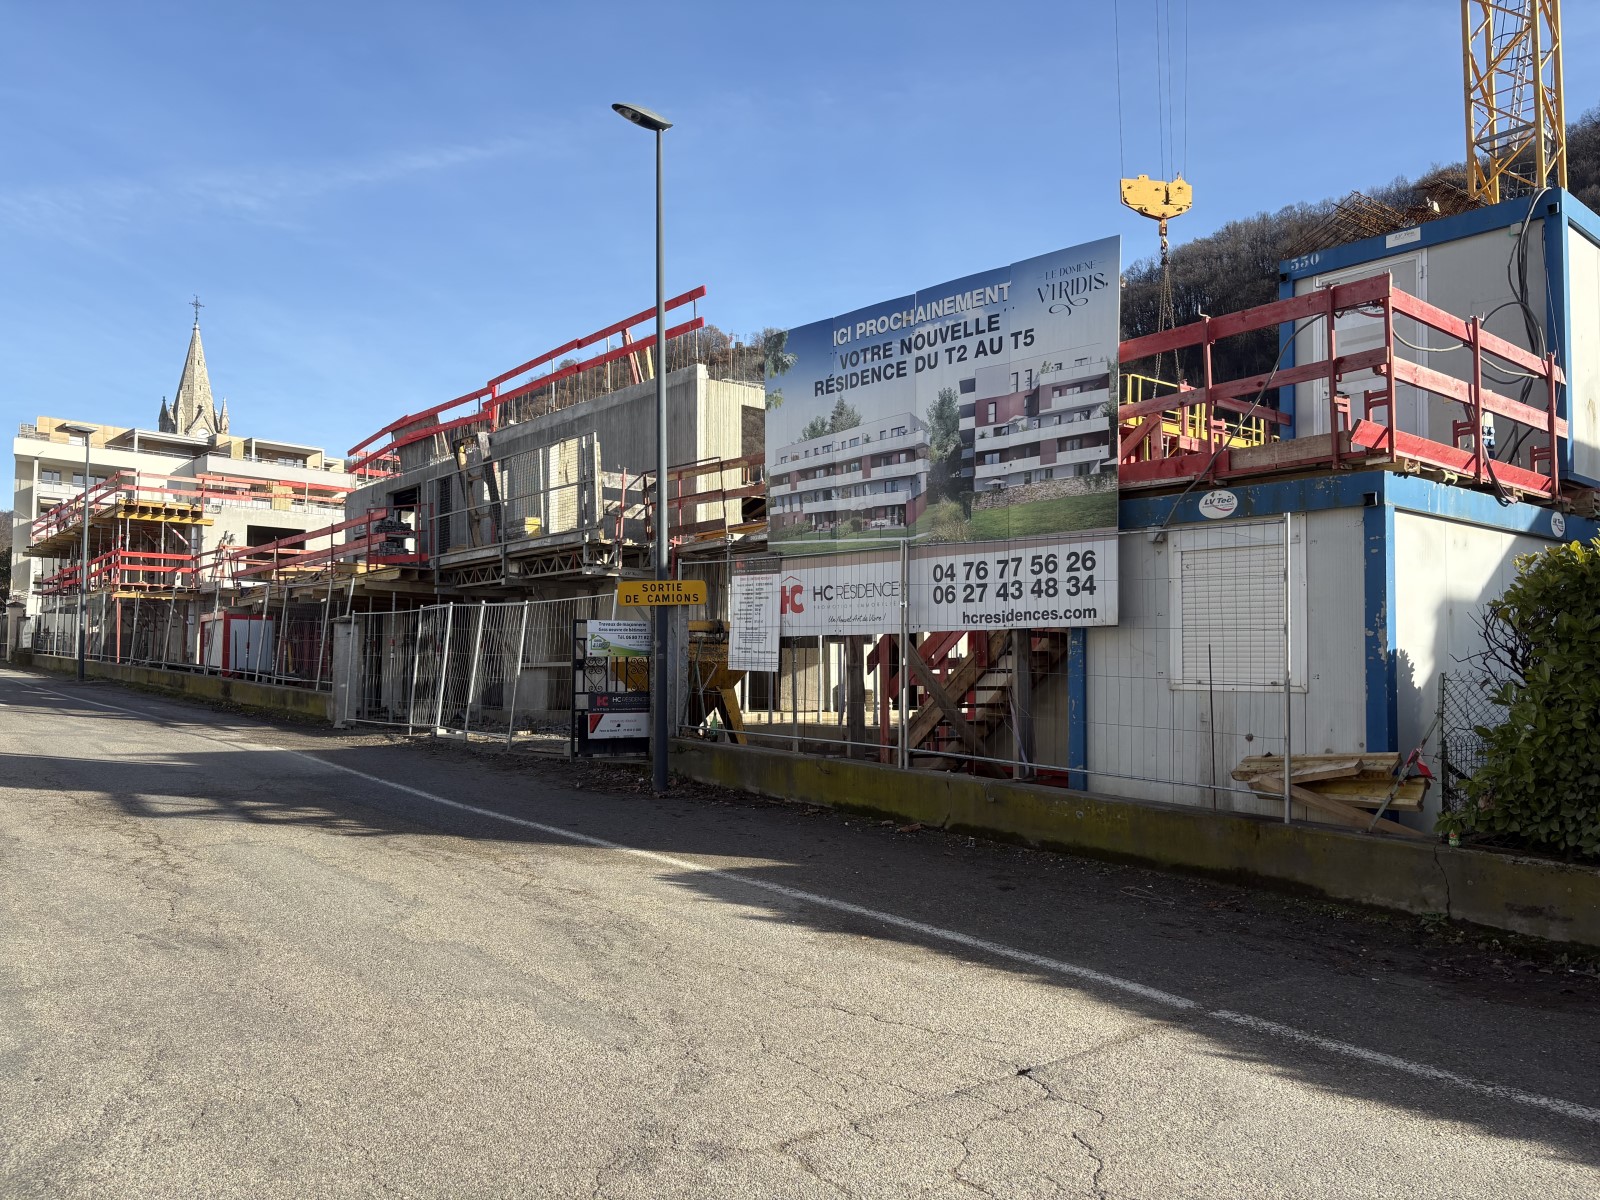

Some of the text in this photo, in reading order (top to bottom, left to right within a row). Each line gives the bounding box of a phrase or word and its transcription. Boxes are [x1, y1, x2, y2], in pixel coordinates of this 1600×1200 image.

[1045, 270, 1057, 280] LE
[833, 281, 1012, 347] ICI PROCHAINEMENT
[839, 313, 1001, 370] VOTRE NOUVELLE
[814, 328, 1035, 398] RÉSIDENCE DU T2 AU T5
[932, 550, 1097, 583] 04 76 77 56 26
[625, 593, 699, 604] DE CAMIONS
[642, 583, 683, 592] SORTIE
[780, 584, 804, 614] HC
[813, 581, 901, 601] HC RÉSIDENCE
[932, 574, 1097, 605] 06 27 43 48 34
[962, 607, 1097, 624] hcresidences.com
